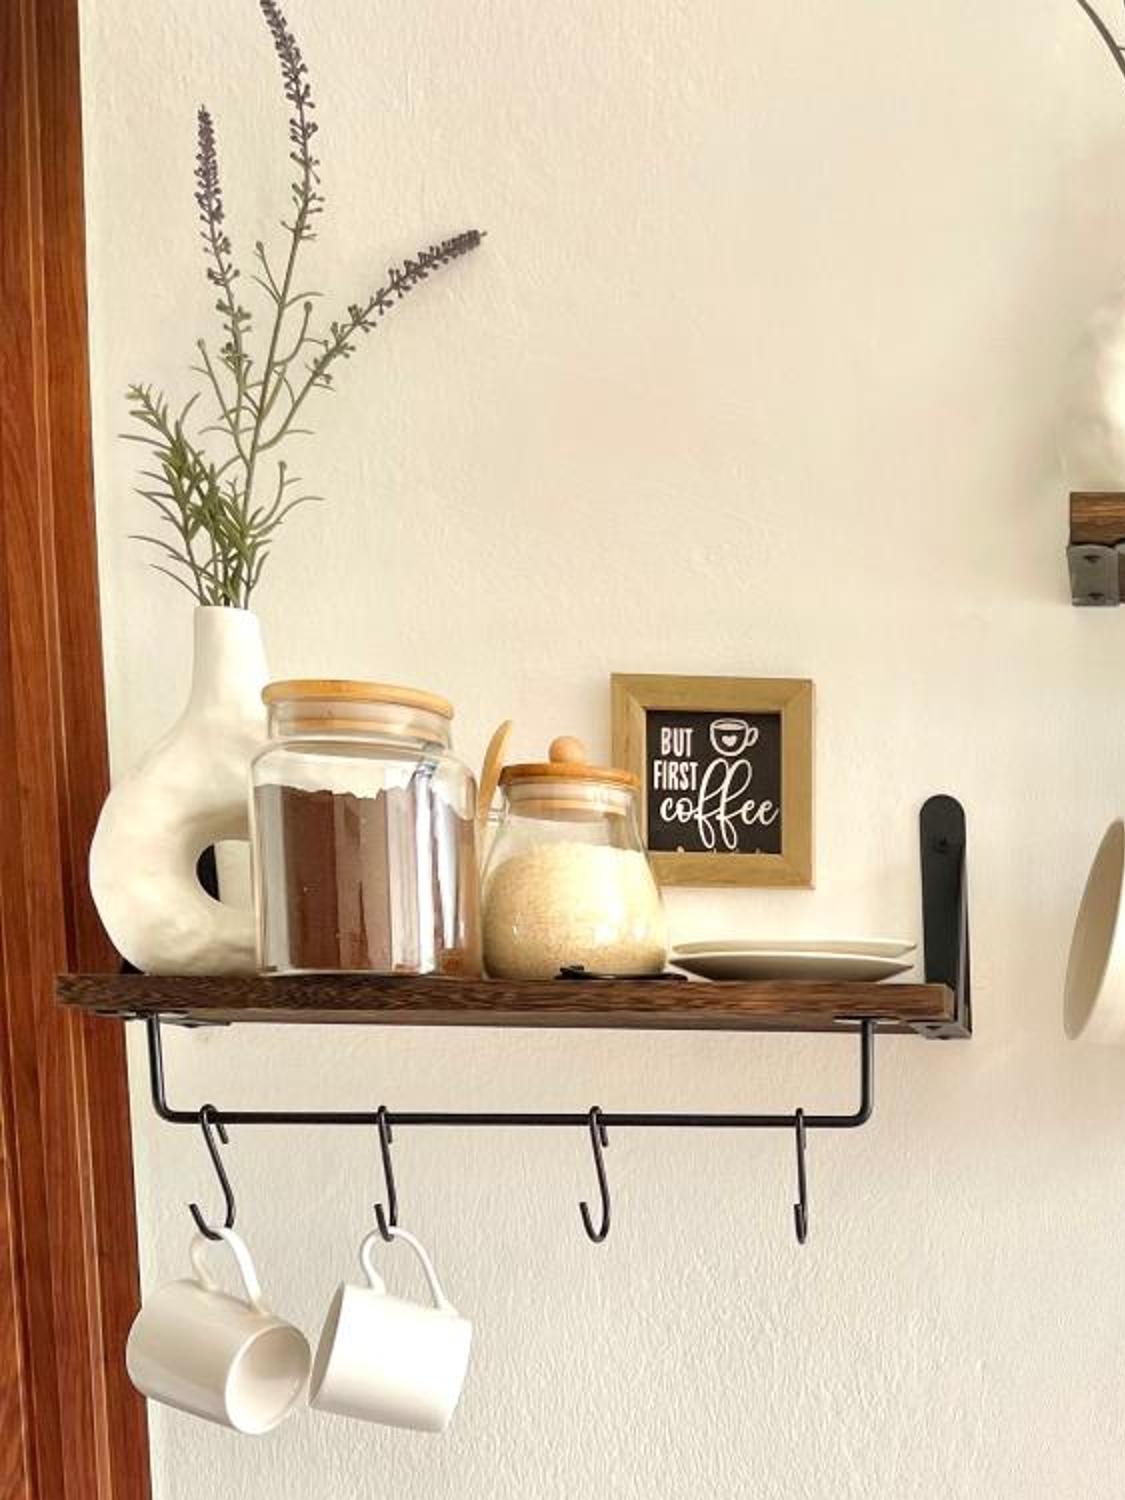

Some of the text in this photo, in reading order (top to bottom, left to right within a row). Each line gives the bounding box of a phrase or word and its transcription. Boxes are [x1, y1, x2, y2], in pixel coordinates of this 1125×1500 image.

[661, 727, 693, 757] BUT
[653, 760, 698, 791] FIRST
[660, 758, 779, 849] coffee
